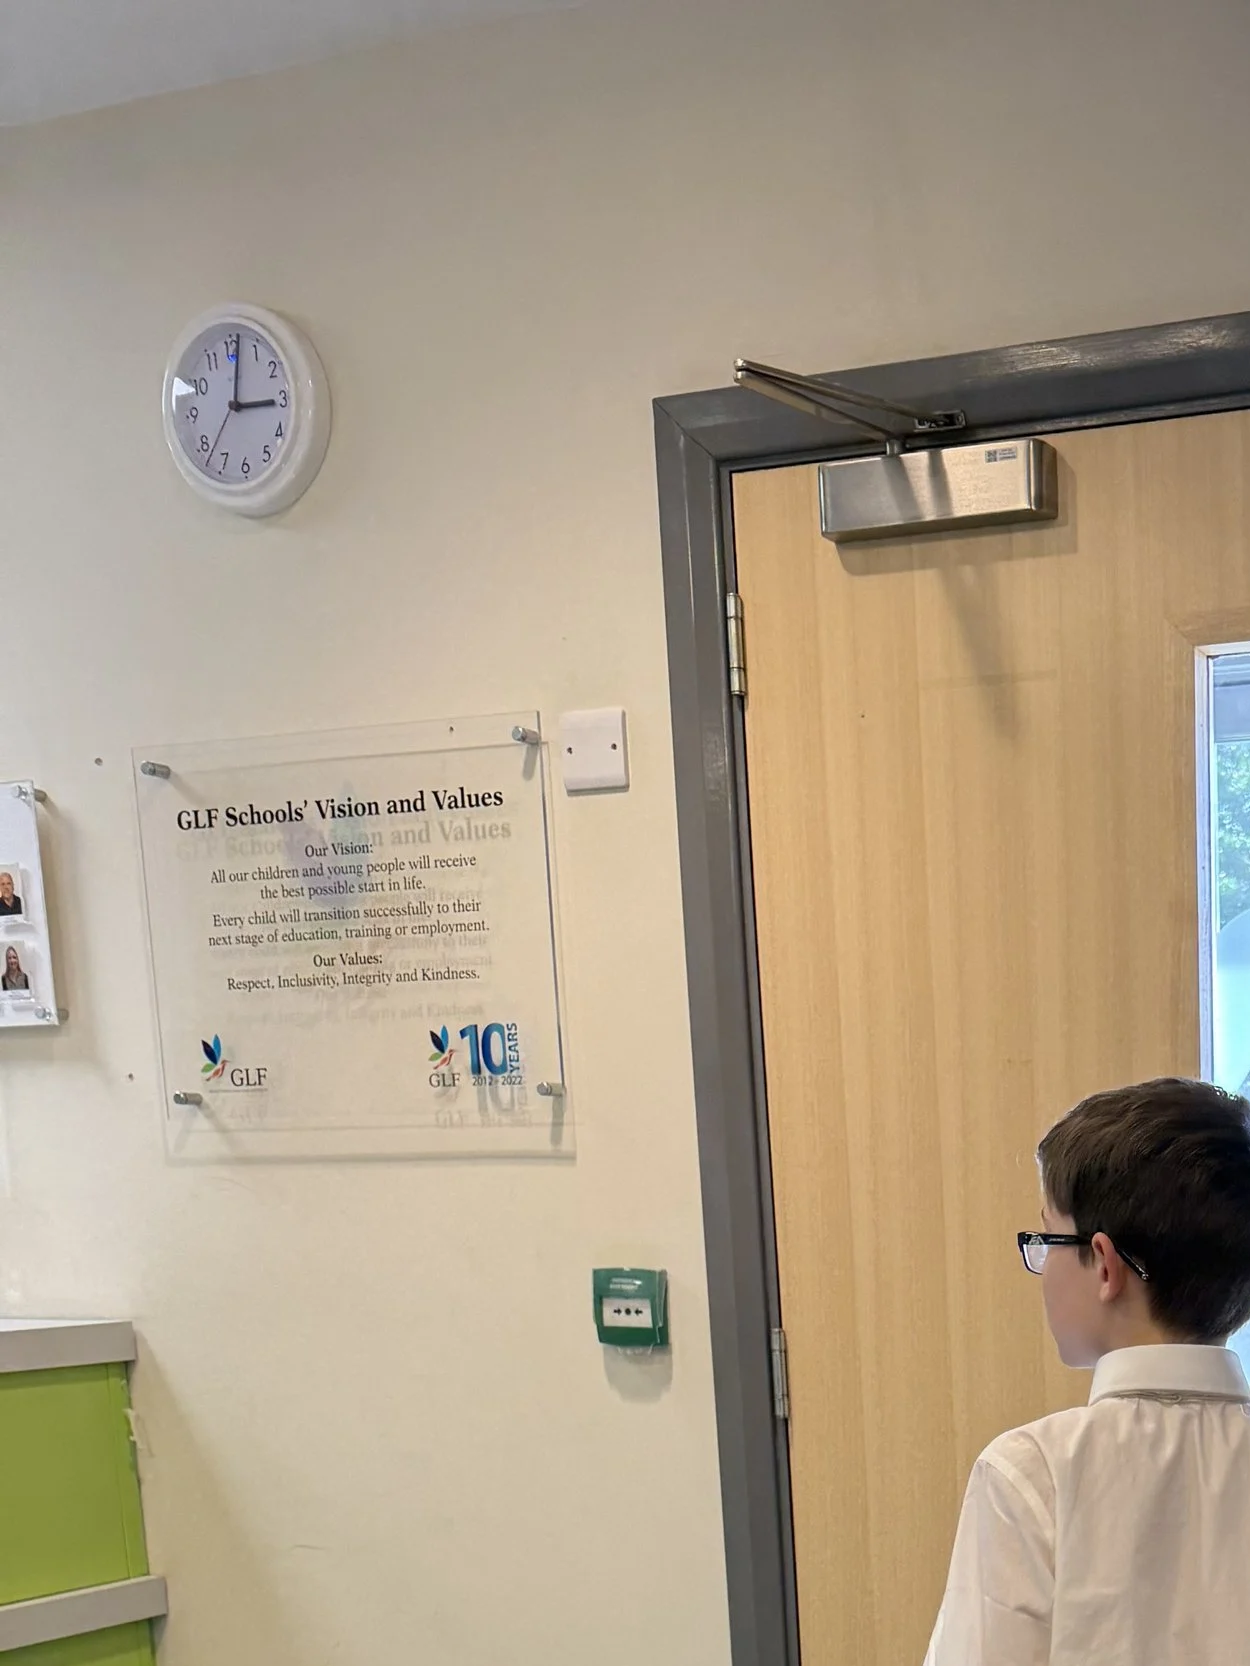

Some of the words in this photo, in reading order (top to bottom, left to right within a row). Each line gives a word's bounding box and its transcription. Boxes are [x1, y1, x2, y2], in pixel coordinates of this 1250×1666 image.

[224, 339, 239, 360] 12
[253, 344, 258, 362] 1
[207, 352, 218, 372] 11
[268, 361, 277, 378] 2
[194, 378, 208, 396] 10
[279, 390, 288, 408] 3
[190, 407, 198, 424] 9
[275, 421, 283, 438] 4
[201, 435, 210, 452] 8
[220, 452, 229, 470] 7
[262, 445, 271, 462] 5
[241, 457, 250, 474] 6
[177, 808, 219, 830] GLF
[315, 797, 380, 819] Vision
[386, 790, 426, 814] and
[431, 786, 504, 810] Values
[305, 844, 329, 857] Our
[331, 843, 373, 856] Vision:
[210, 869, 226, 884] All
[229, 871, 249, 882] our
[252, 865, 299, 881] children
[302, 863, 324, 877] and
[327, 864, 363, 879] young
[366, 858, 405, 876] people
[409, 855, 430, 869] will
[434, 853, 477, 869] receive
[260, 885, 279, 899] the
[281, 884, 304, 898] best
[308, 881, 355, 900] possible
[358, 881, 384, 893] start
[388, 879, 400, 891] in
[403, 876, 426, 890] life.
[213, 914, 244, 928] Every
[247, 910, 277, 925] child
[280, 909, 300, 923] will
[304, 906, 360, 922] transition
[363, 900, 433, 919] successfully
[437, 903, 449, 914] to
[453, 899, 481, 912] their
[208, 934, 233, 946] next
[235, 934, 264, 948] stage
[267, 929, 279, 943] of
[281, 927, 342, 942] education,
[345, 924, 392, 939] training
[395, 925, 408, 936] or
[411, 920, 490, 937] employment.
[313, 954, 337, 967] Our
[339, 952, 383, 966] Values:
[278, 973, 339, 989] Inclusivity,
[342, 970, 392, 987] Integrity
[396, 969, 418, 983] and
[421, 966, 480, 981] Kindness.
[459, 1022, 508, 1076] 10
[506, 1022, 520, 1074] YEARS
[230, 1068, 268, 1087] GLF
[429, 1073, 460, 1088] GLF
[501, 1075, 523, 1086] 2022
